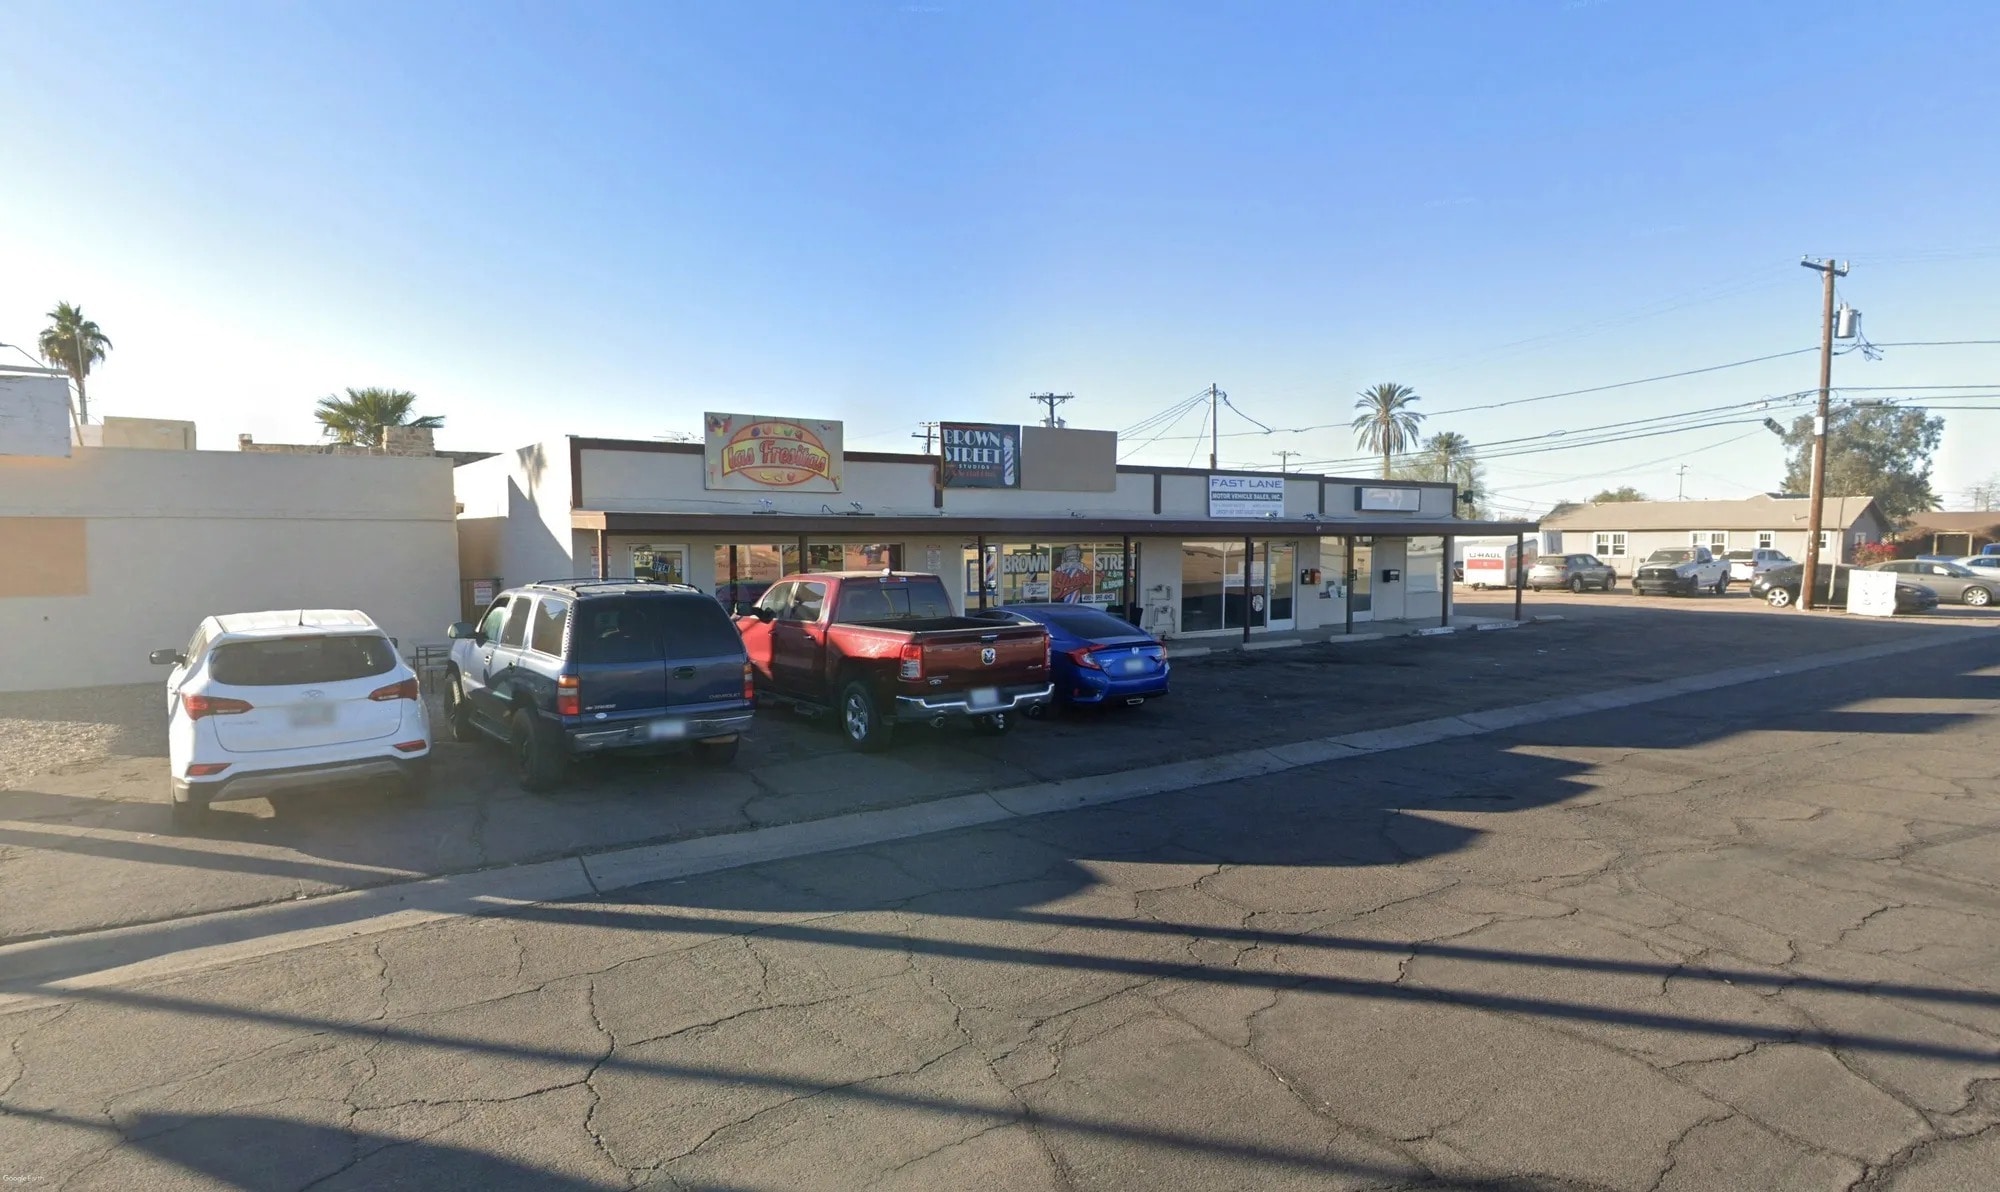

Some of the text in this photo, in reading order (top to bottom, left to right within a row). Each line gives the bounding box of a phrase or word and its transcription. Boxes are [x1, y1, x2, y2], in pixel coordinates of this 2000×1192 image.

[943, 429, 1001, 447] BROWN
[759, 440, 826, 472] Fresitas
[944, 446, 1002, 464] STREET
[1211, 479, 1282, 488] FAST LANE
[1003, 553, 1137, 573] BROWN STRET
